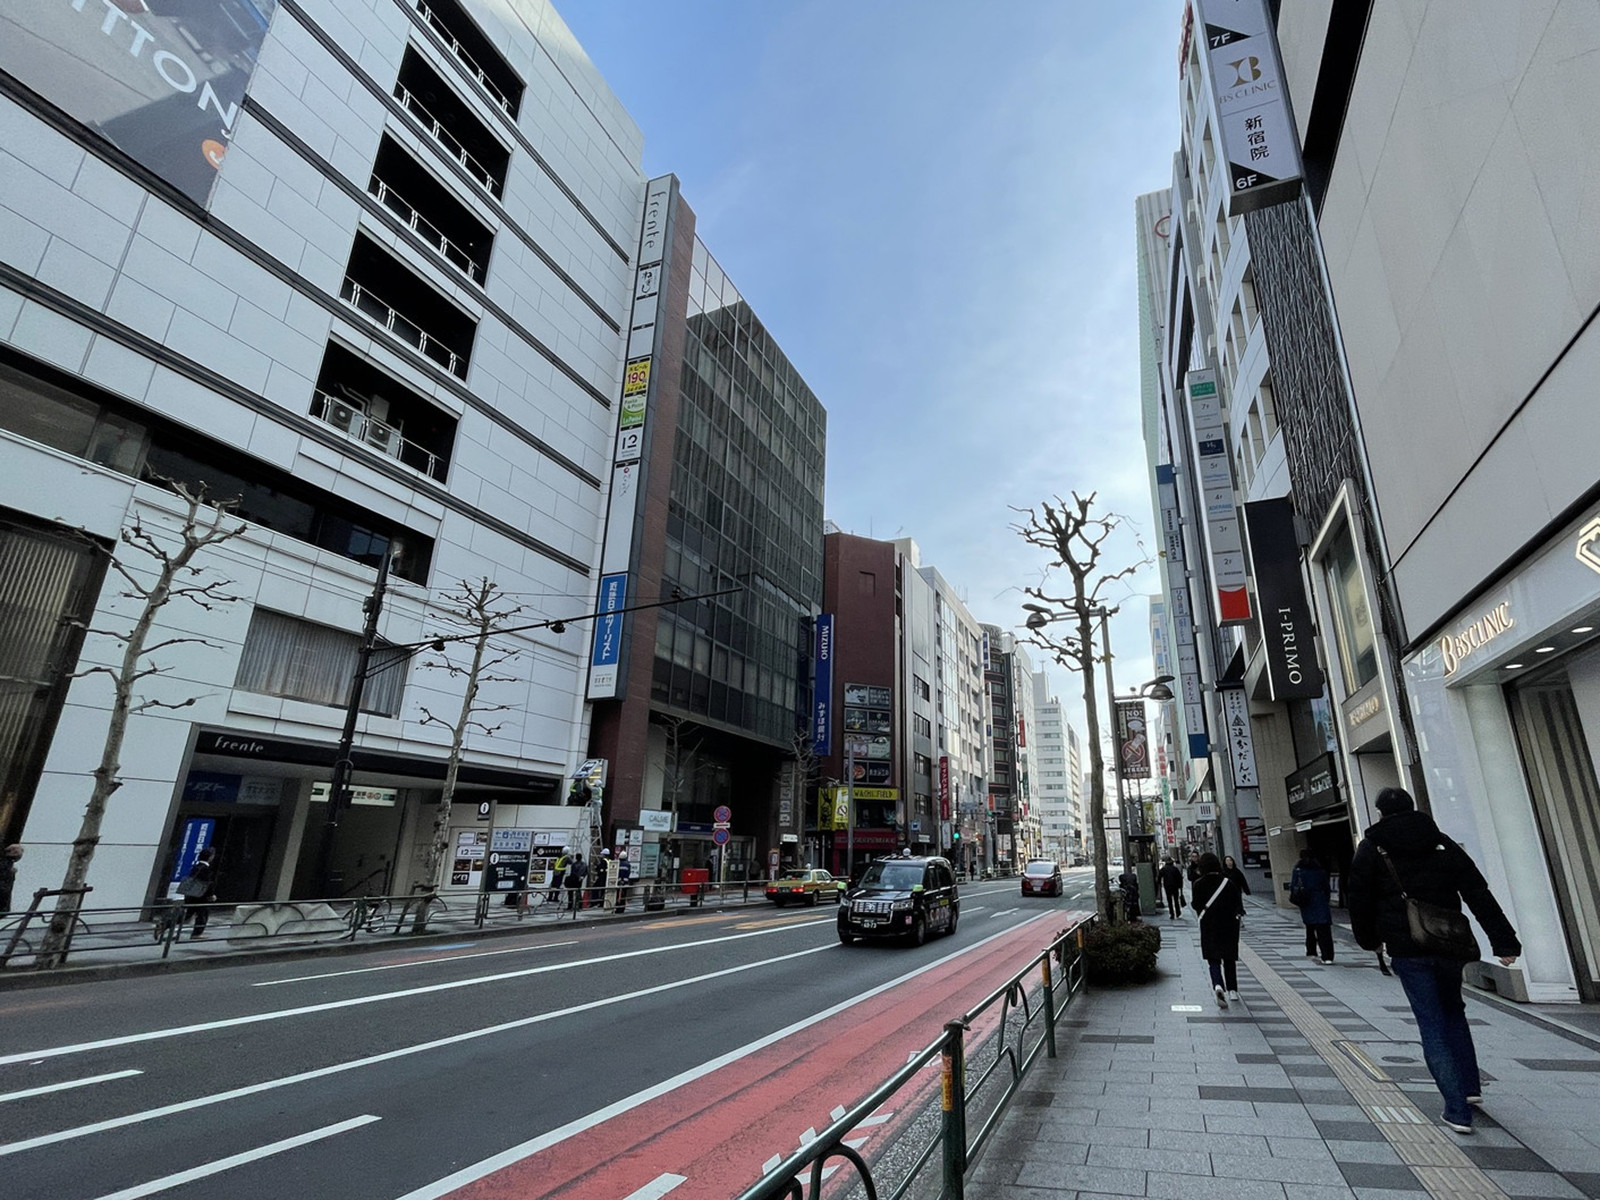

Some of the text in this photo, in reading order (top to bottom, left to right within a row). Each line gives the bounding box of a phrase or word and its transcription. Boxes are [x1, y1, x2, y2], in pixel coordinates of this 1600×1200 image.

[1210, 32, 1231, 47] 7F
[1235, 80, 1276, 98] CLINIC
[1245, 115, 1269, 161] 新宿院
[1236, 174, 1257, 189] 6F
[627, 370, 646, 384] 190
[820, 625, 830, 660] MIZUHO
[1278, 607, 1302, 685] I-PRIMO
